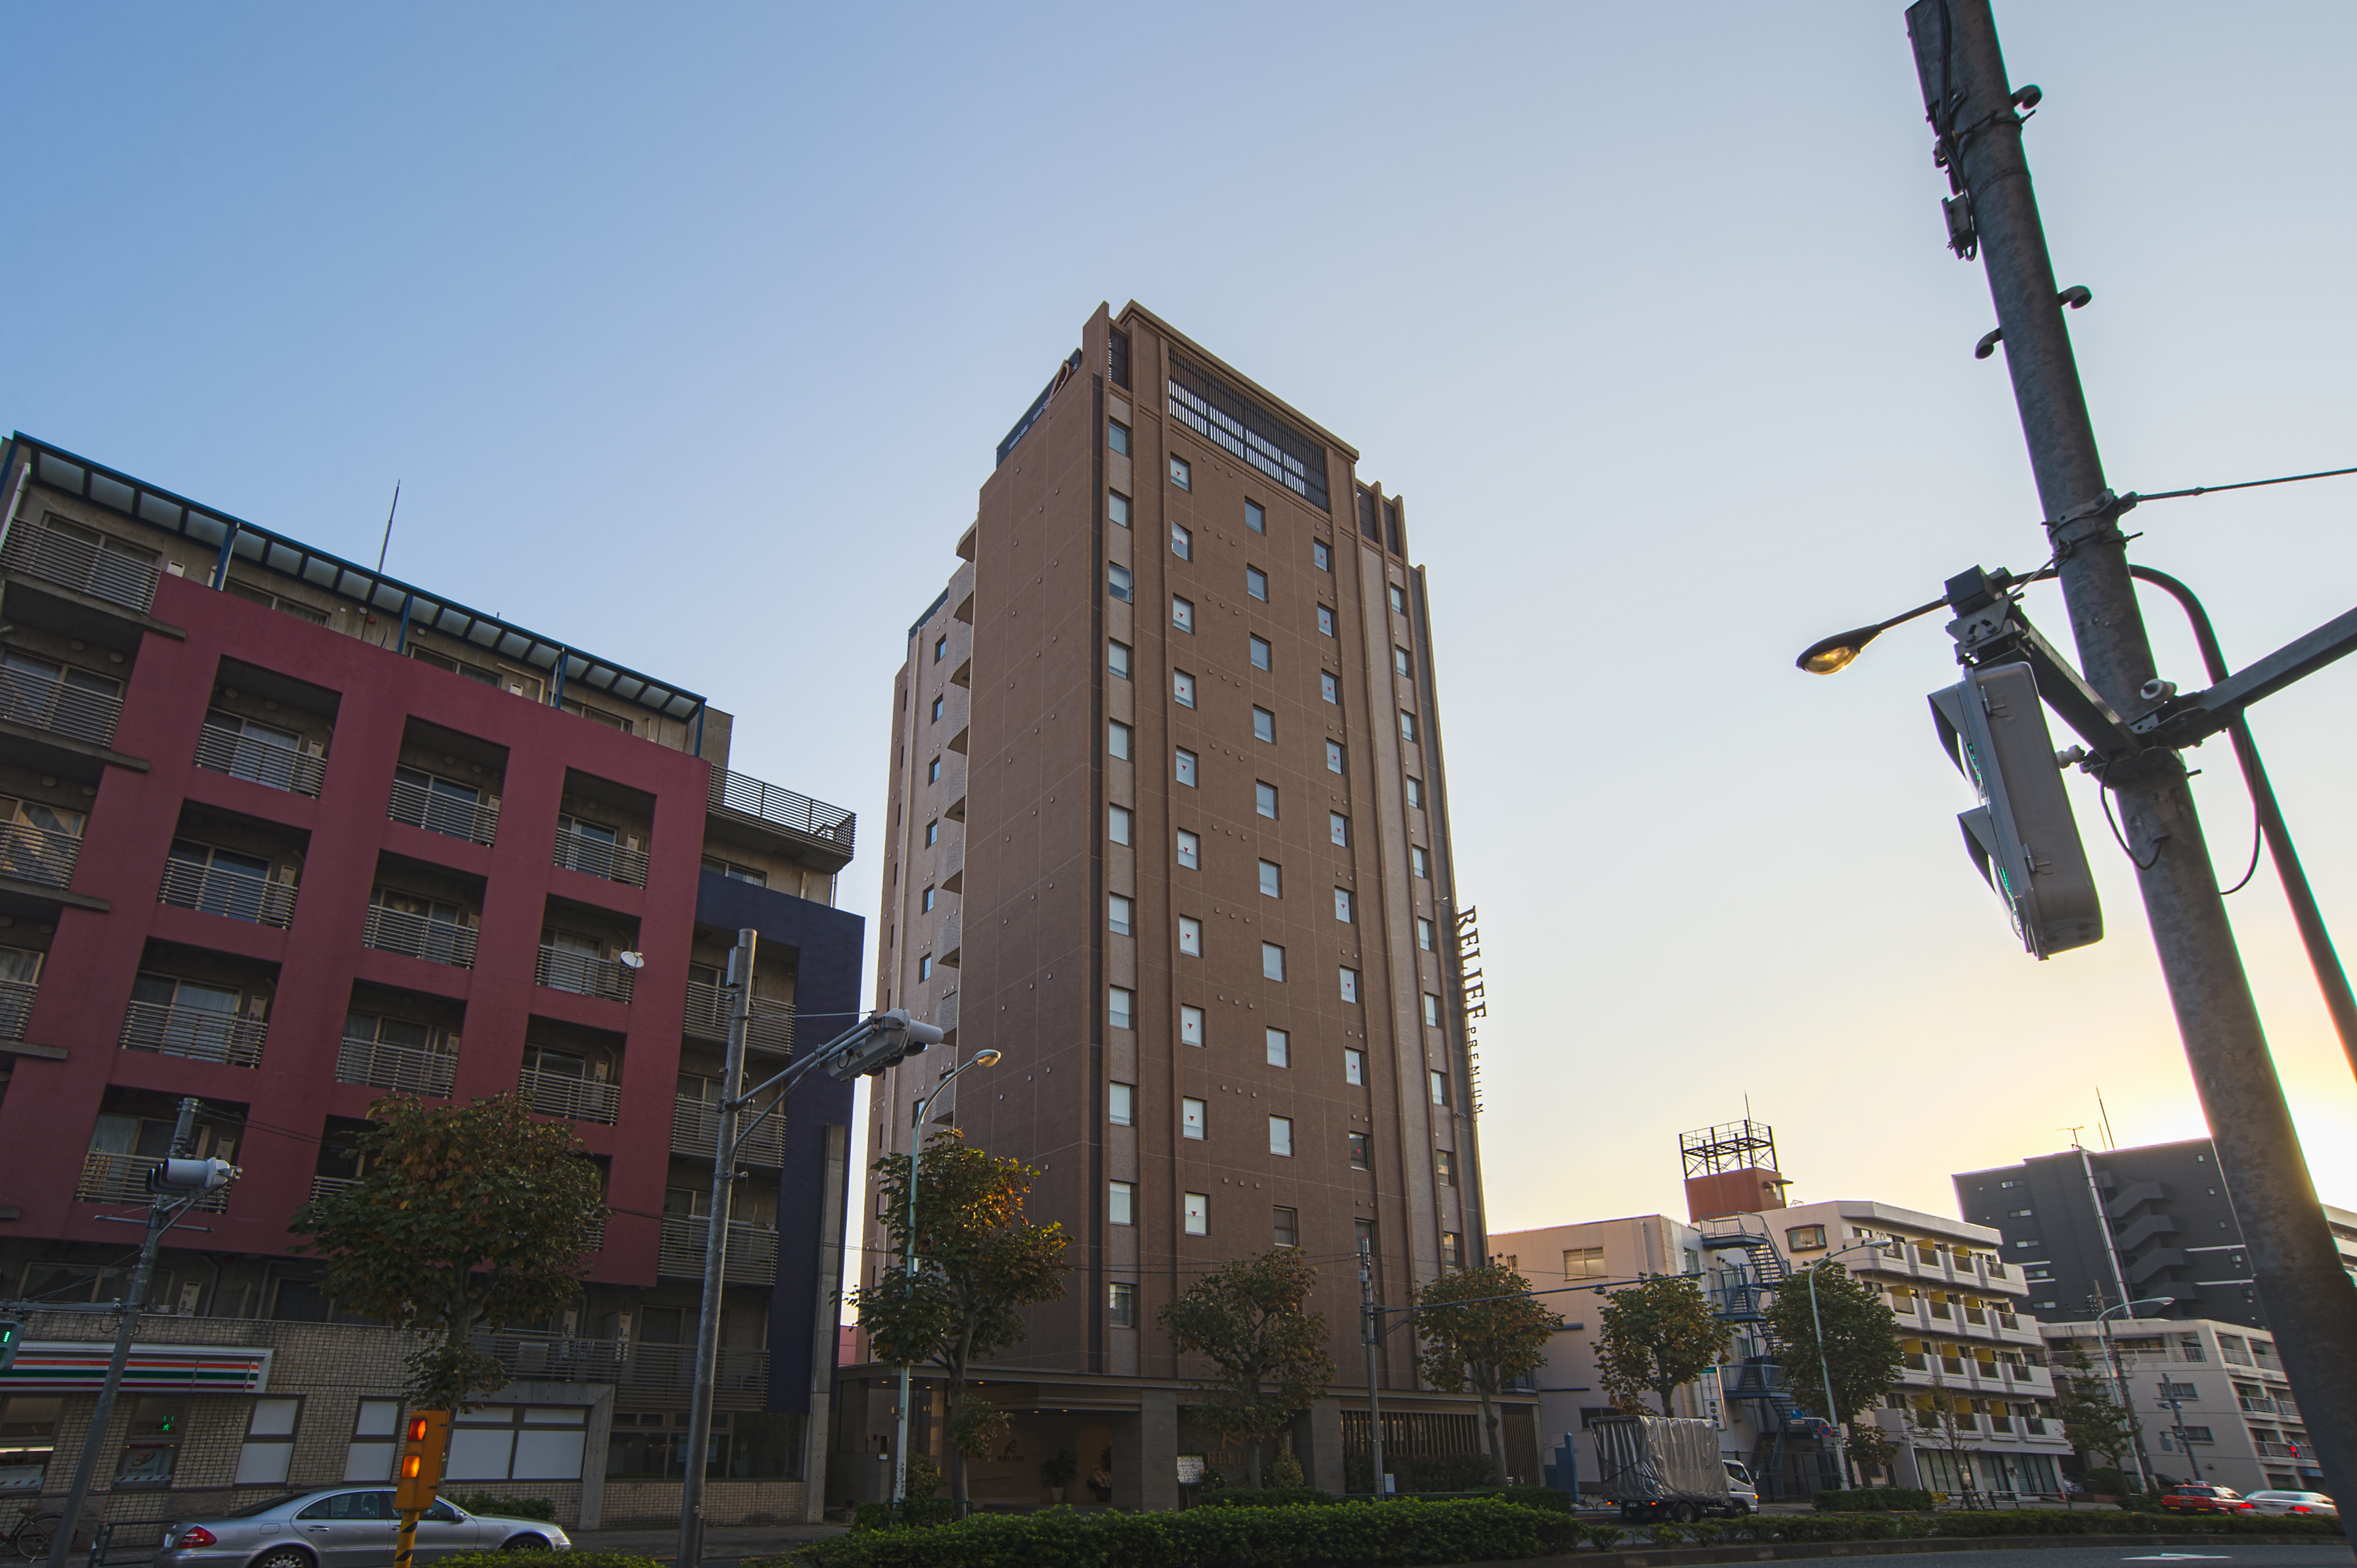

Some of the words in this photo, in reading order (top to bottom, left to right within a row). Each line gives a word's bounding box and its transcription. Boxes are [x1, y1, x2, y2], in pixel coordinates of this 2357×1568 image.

[1456, 905, 1487, 1018] RELIEF
[1466, 1026, 1484, 1114] PREMIUM
[1207, 1452, 1249, 1465] RELIE
